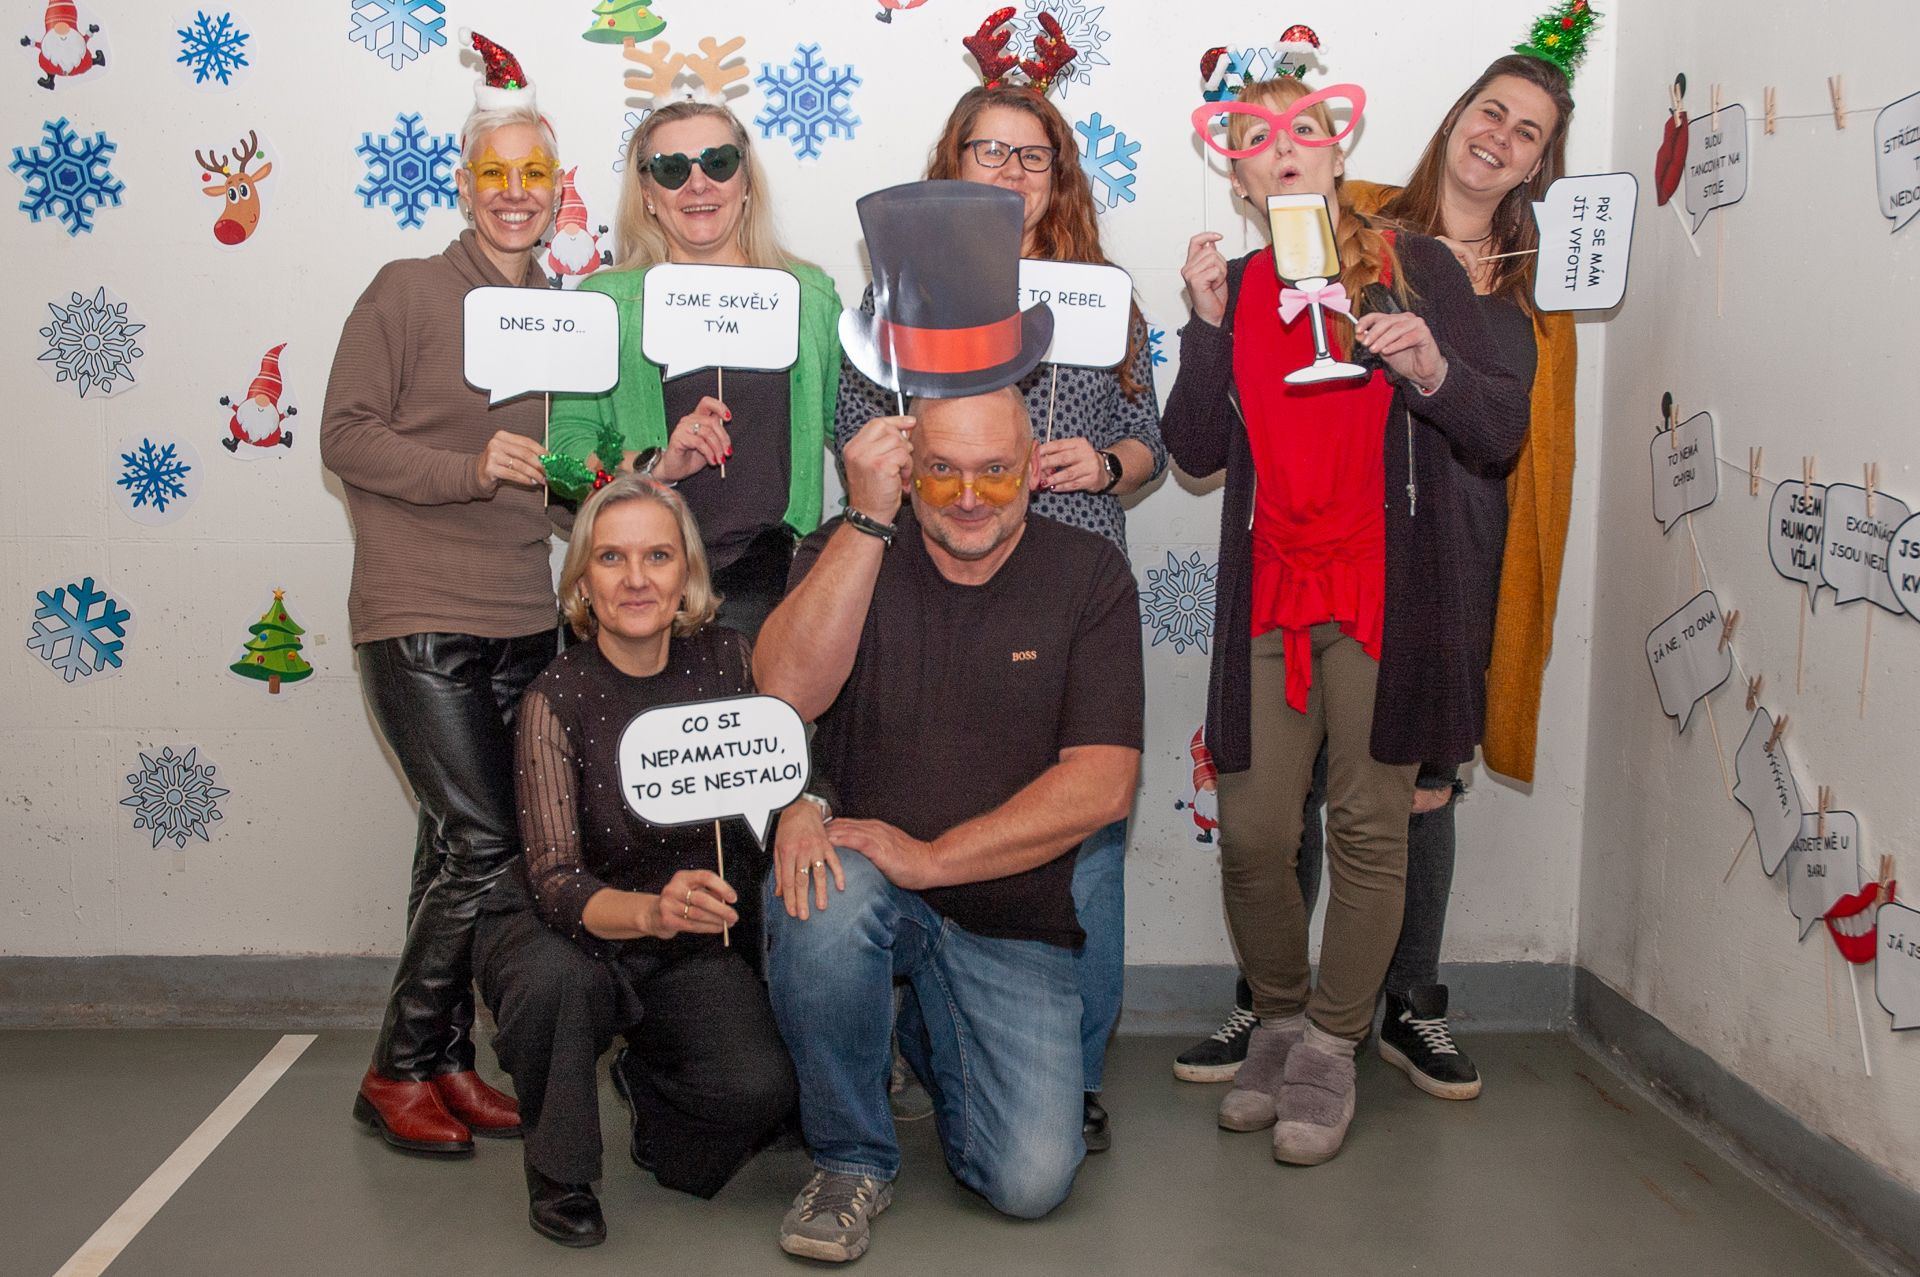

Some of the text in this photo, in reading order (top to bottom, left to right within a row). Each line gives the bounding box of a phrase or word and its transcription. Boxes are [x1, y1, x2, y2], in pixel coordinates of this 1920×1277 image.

[1690, 152, 1740, 176] TANCOVAT NA
[1703, 180, 1724, 198] STOLE
[1564, 195, 1590, 291] JÍT VYFOTIT
[1587, 196, 1613, 287] PRÝ SE MÁM
[665, 292, 779, 311] JSME SKVĚLÝ
[1029, 289, 1051, 304] TO
[1058, 291, 1106, 308] REBEL
[500, 316, 545, 332] DNES
[704, 315, 739, 334] TÝM
[1668, 453, 1678, 467] TO
[1790, 493, 1822, 517] JSEM
[1781, 518, 1823, 544] RUMOV
[1791, 543, 1816, 571] VÍLA
[1829, 542, 1861, 562] JSOU
[1654, 643, 1665, 663] JÁ
[1681, 625, 1695, 640] TO
[1697, 610, 1716, 631] ONA
[1012, 650, 1037, 662] BOSS
[682, 712, 741, 734] CO SI
[641, 737, 785, 770] NEPAMATUJU,
[632, 762, 802, 800] TO SE NESTALO!
[1824, 831, 1838, 850] MĚ
[1841, 835, 1849, 850] U
[1807, 864, 1827, 877] BARU
[1887, 933, 1904, 952] JÁ
